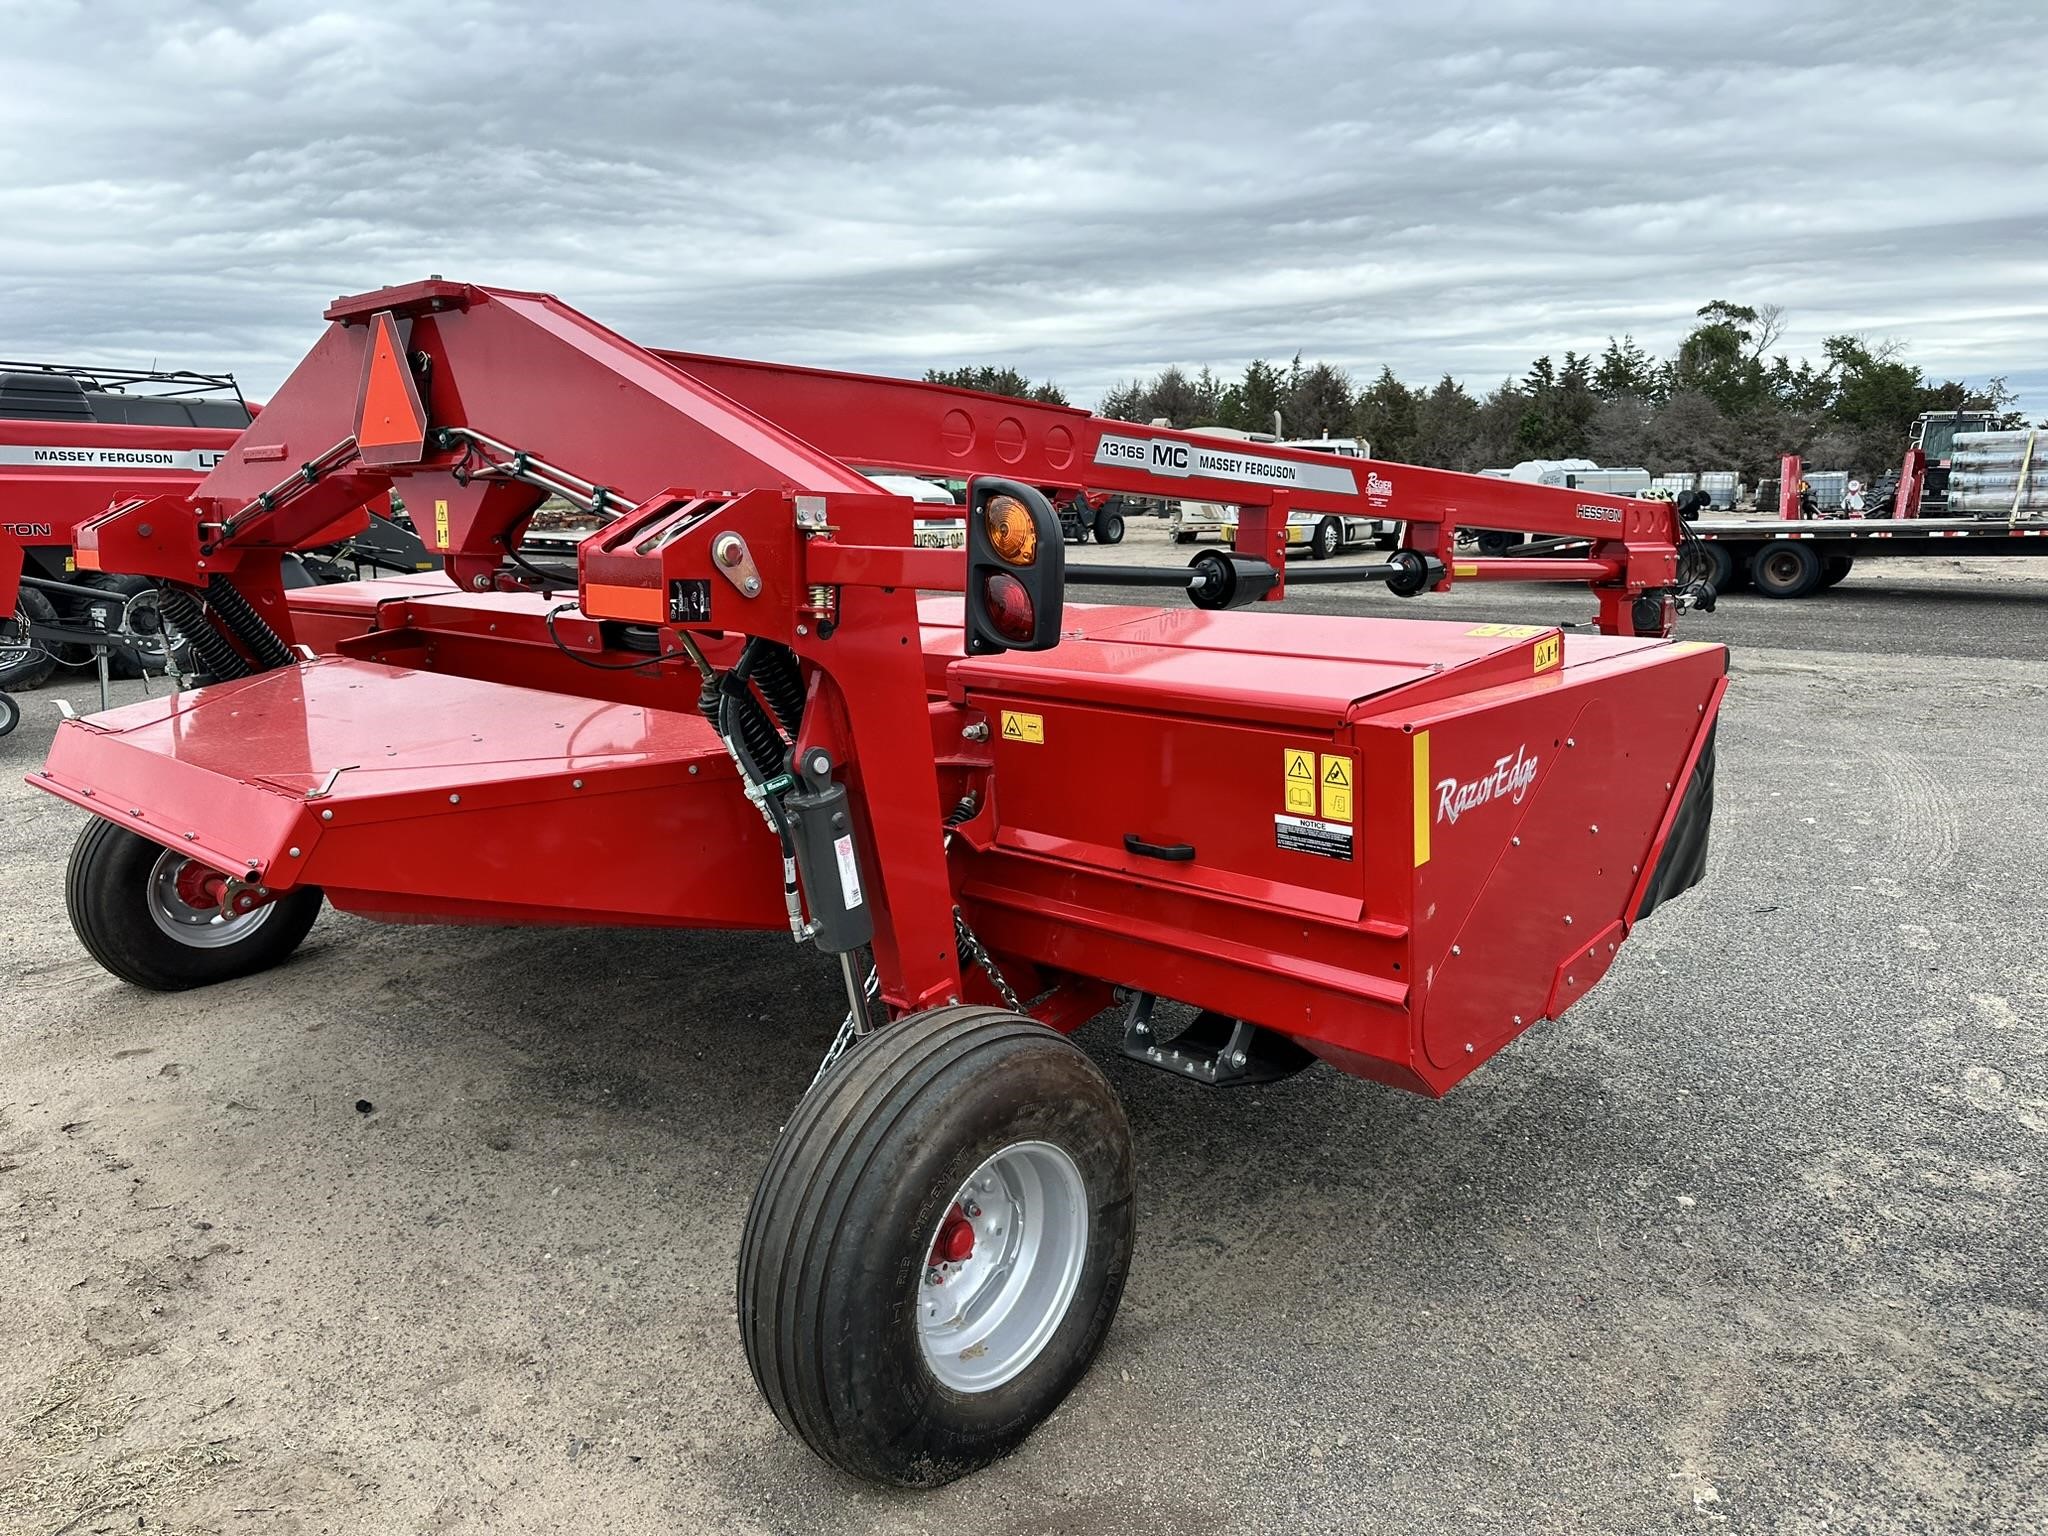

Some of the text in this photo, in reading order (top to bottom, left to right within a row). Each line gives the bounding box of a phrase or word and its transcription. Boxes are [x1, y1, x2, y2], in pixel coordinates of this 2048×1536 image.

[34, 450, 173, 464] MASSEY FERGUSON
[1102, 442, 1296, 480] 1316S MC MASSEY FERGUSON
[1576, 504, 1622, 522] HESSTON
[1435, 743, 1538, 825] RazorEdge
[1300, 819, 1326, 830] NOTICE
[911, 1145, 969, 1241] IMPLEMENT
